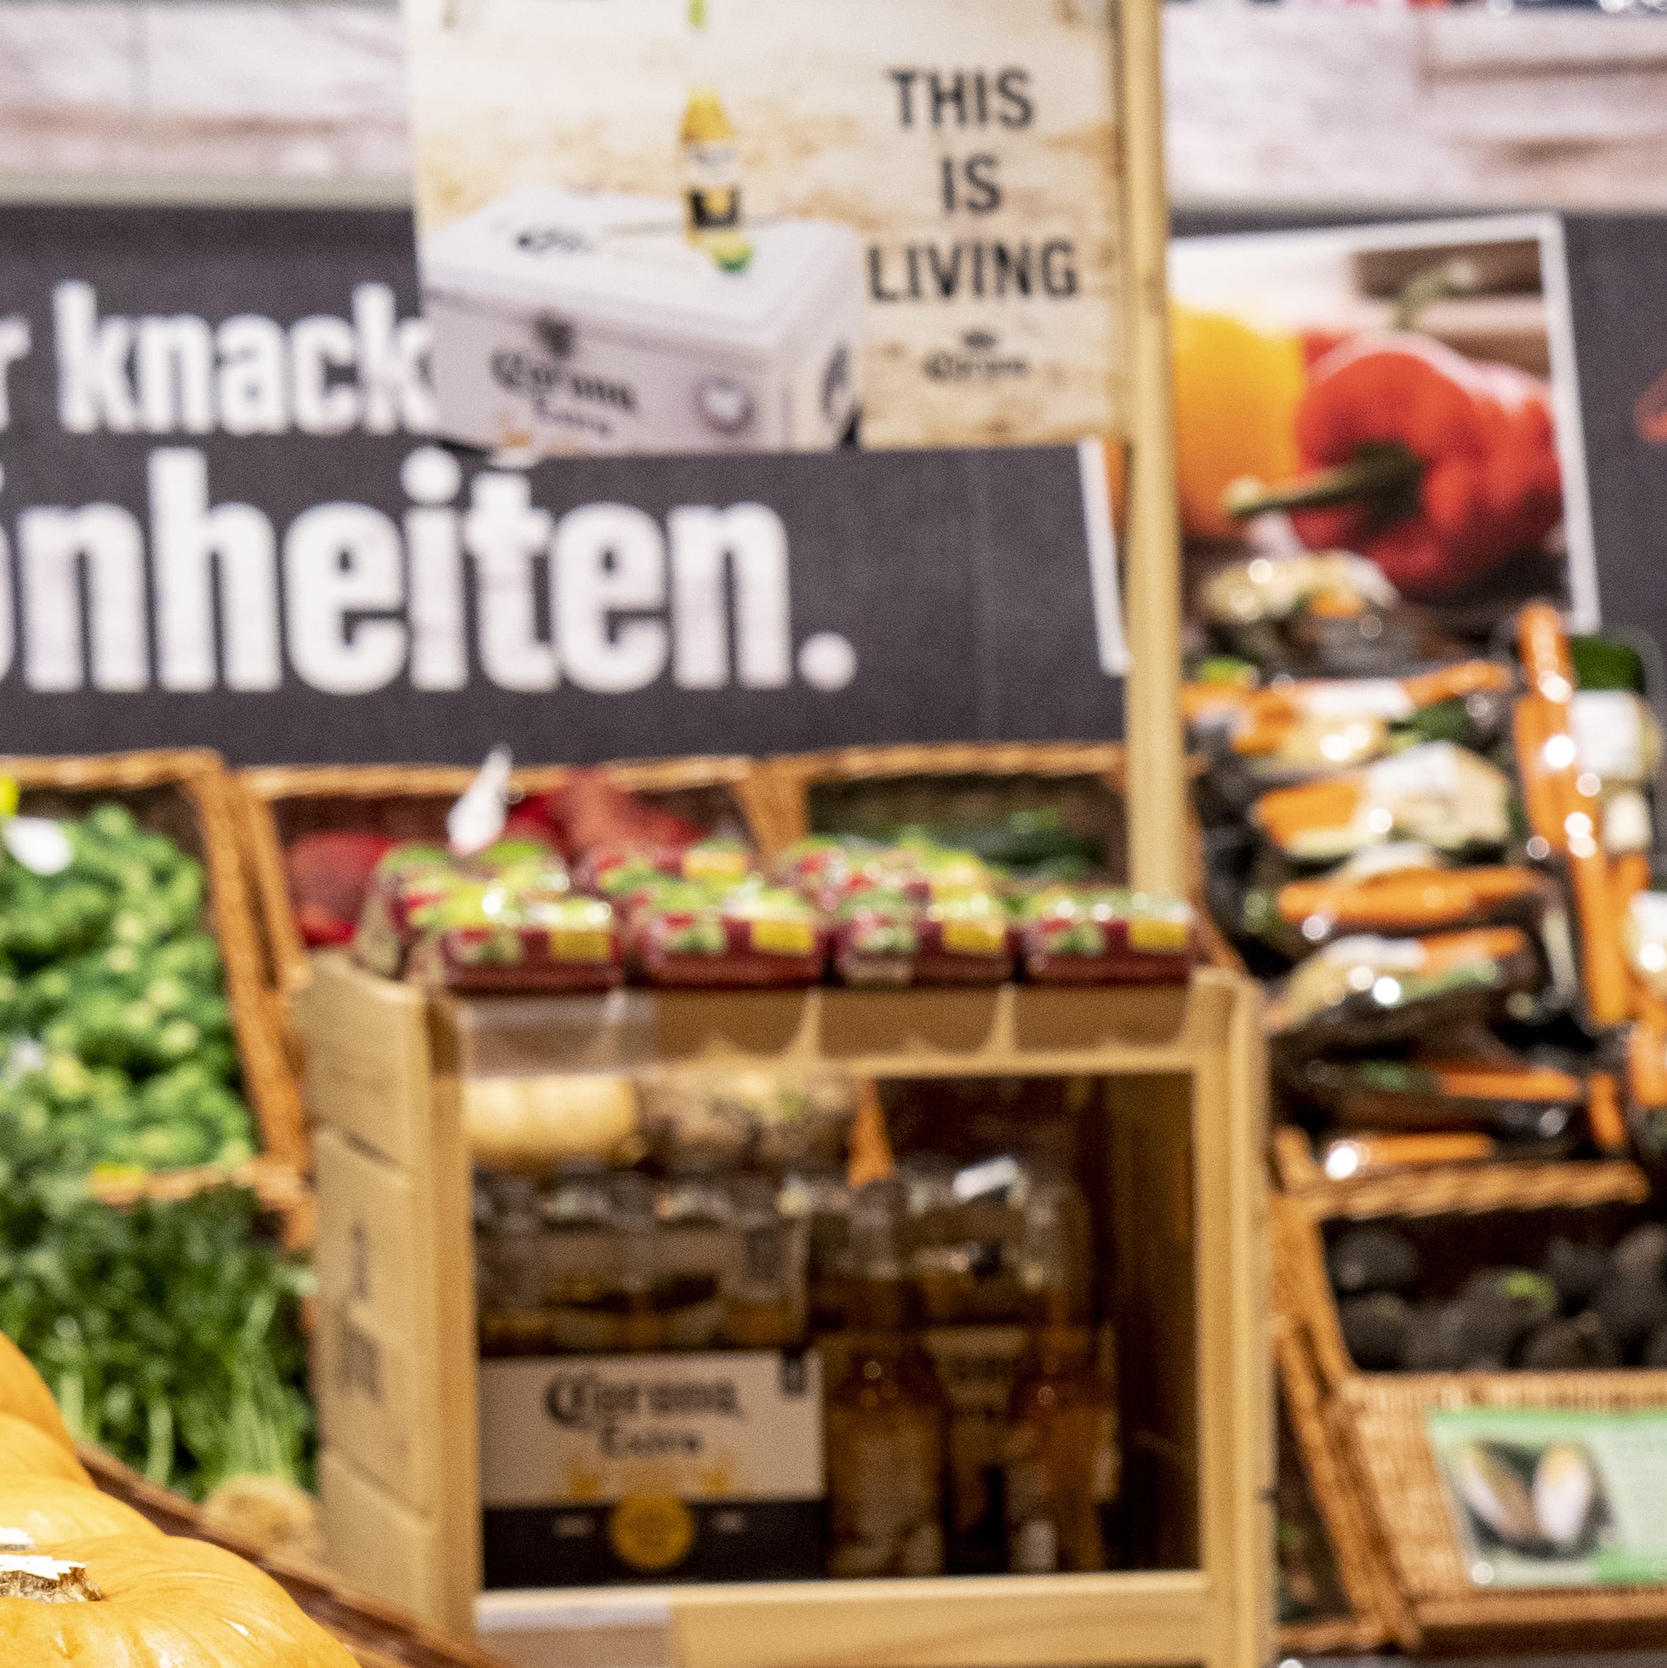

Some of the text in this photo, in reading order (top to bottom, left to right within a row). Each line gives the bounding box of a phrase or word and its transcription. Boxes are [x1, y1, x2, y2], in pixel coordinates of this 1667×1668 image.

[884, 66, 1036, 130] THIS
[939, 153, 1002, 213] IS
[866, 239, 1078, 303] LIVING
[0, 445, 858, 694] nheiten.
[543, 1369, 746, 1431] Corona
